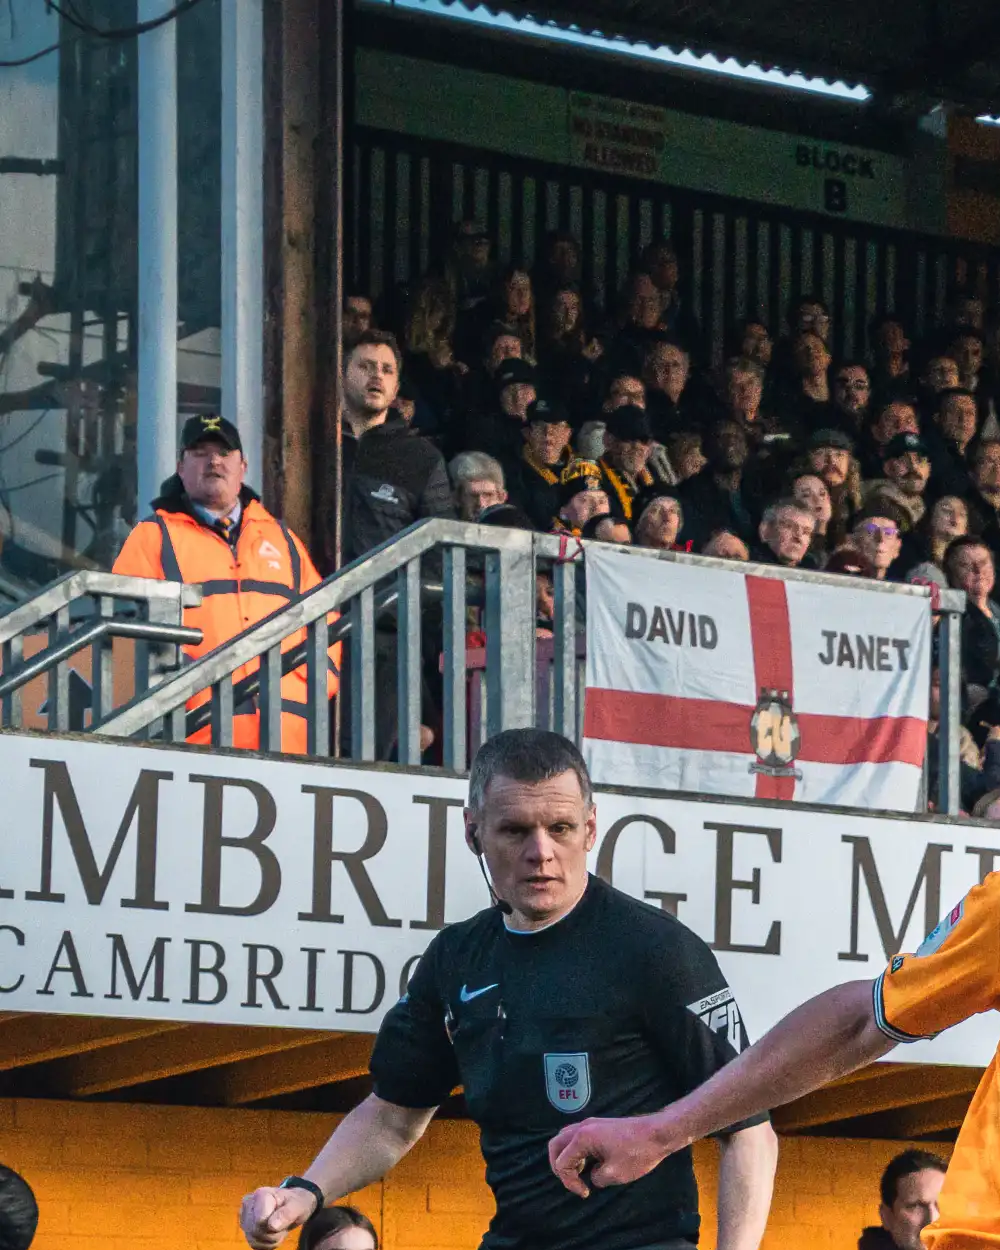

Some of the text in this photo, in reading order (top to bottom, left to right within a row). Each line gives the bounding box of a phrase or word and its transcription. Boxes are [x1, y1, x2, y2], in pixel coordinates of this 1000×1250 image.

[796, 145, 874, 179] BLOCK
[825, 179, 847, 211] B
[625, 602, 718, 650] DAVID
[818, 630, 910, 671] JANET
[0, 758, 782, 956] MBRIGE
[559, 1089, 578, 1100] EFL
